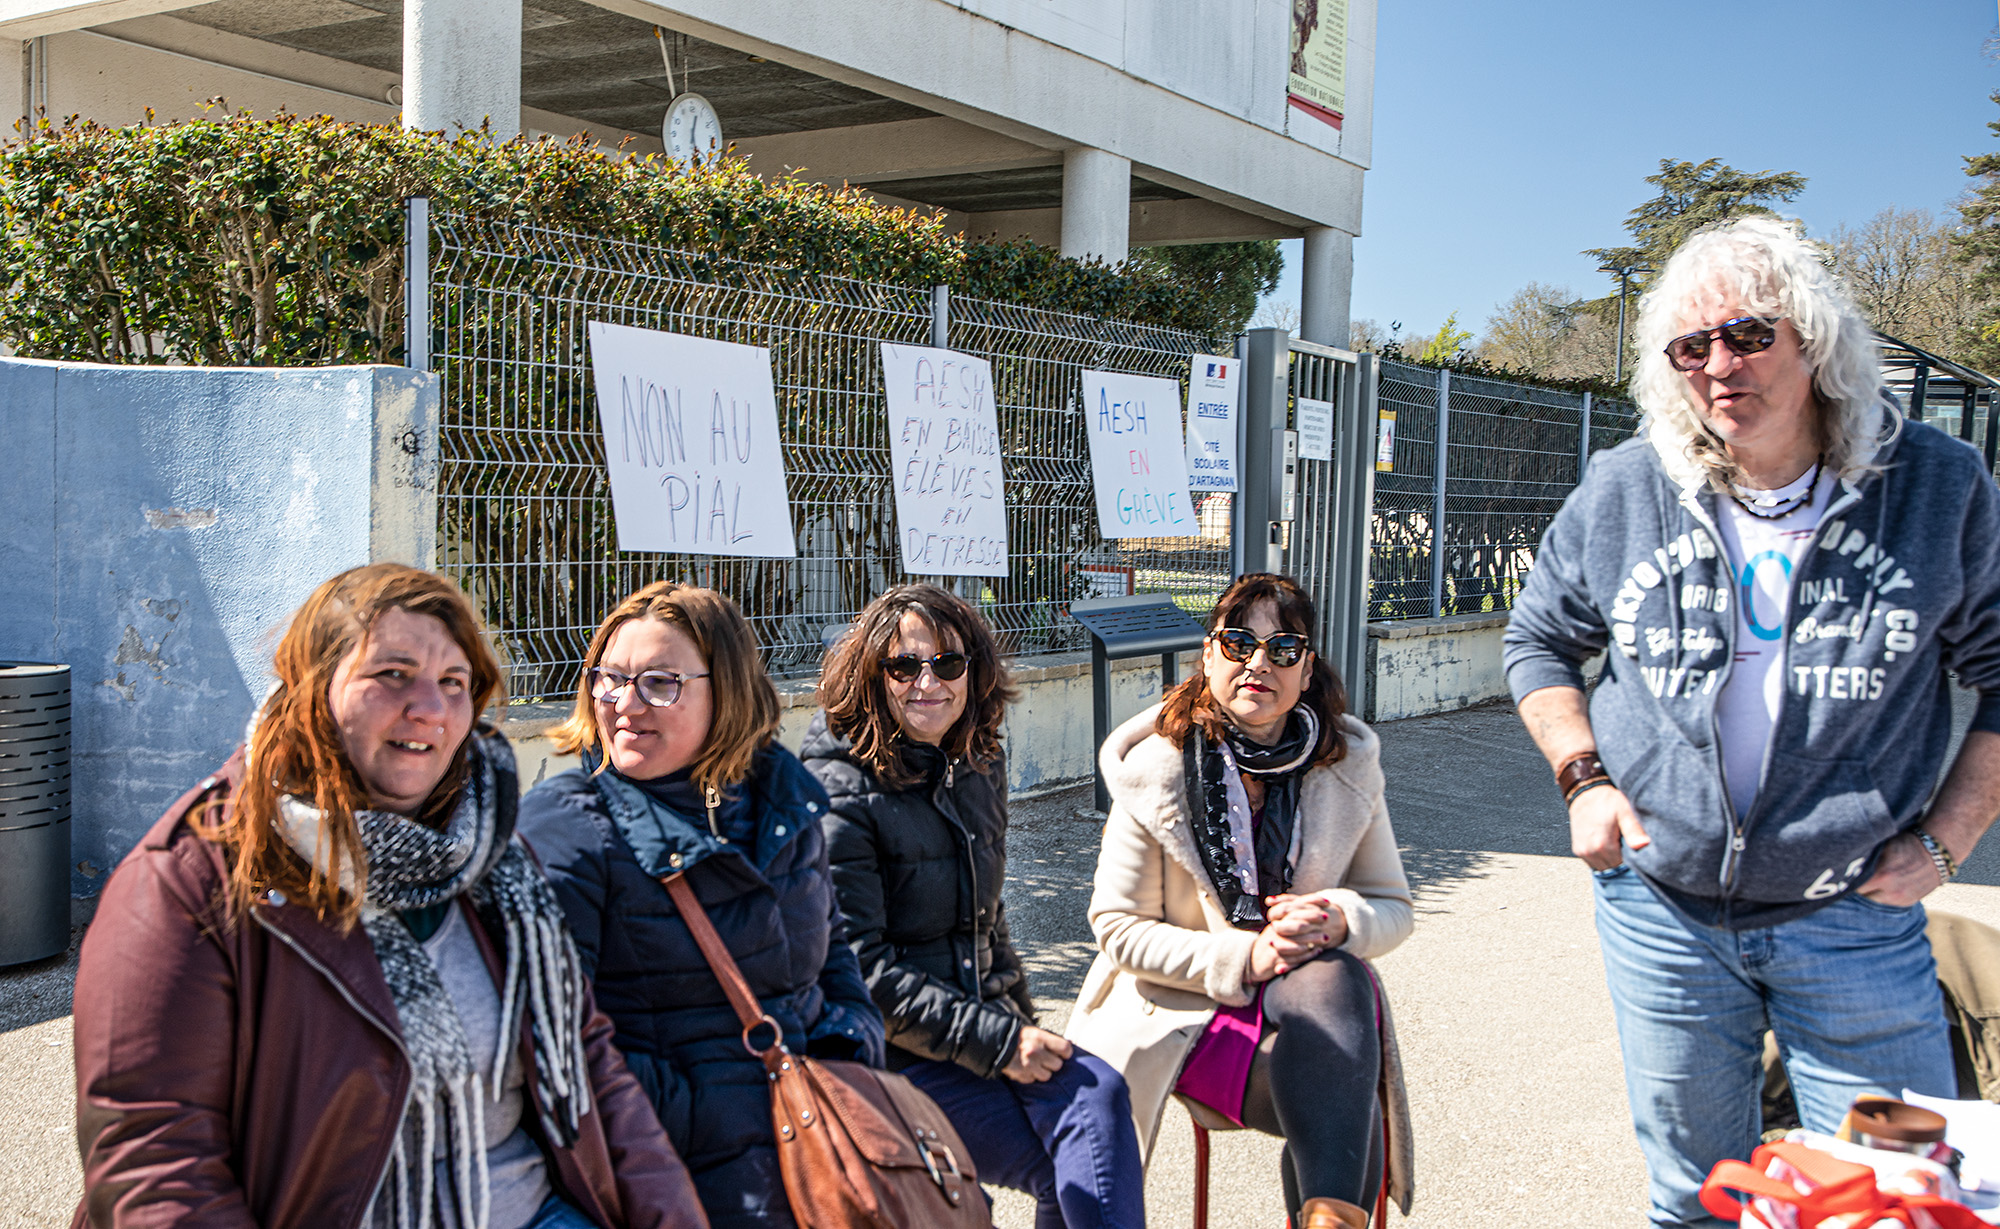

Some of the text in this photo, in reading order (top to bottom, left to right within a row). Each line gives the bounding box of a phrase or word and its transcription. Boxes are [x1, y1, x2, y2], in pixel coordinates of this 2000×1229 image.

[915, 356, 985, 413] AESH
[620, 373, 751, 468] NON AU
[1197, 401, 1229, 417] ENTRÉE
[901, 416, 932, 447] EN
[1203, 440, 1220, 453] CITÉ
[1129, 448, 1150, 475] EN
[1193, 457, 1230, 470] SCOLAIRE
[902, 449, 994, 502] ÉLÈVES
[1188, 474, 1236, 487] D'ARTAGNAN
[941, 506, 972, 527] EN
[1117, 487, 1184, 525] GRÈVE
